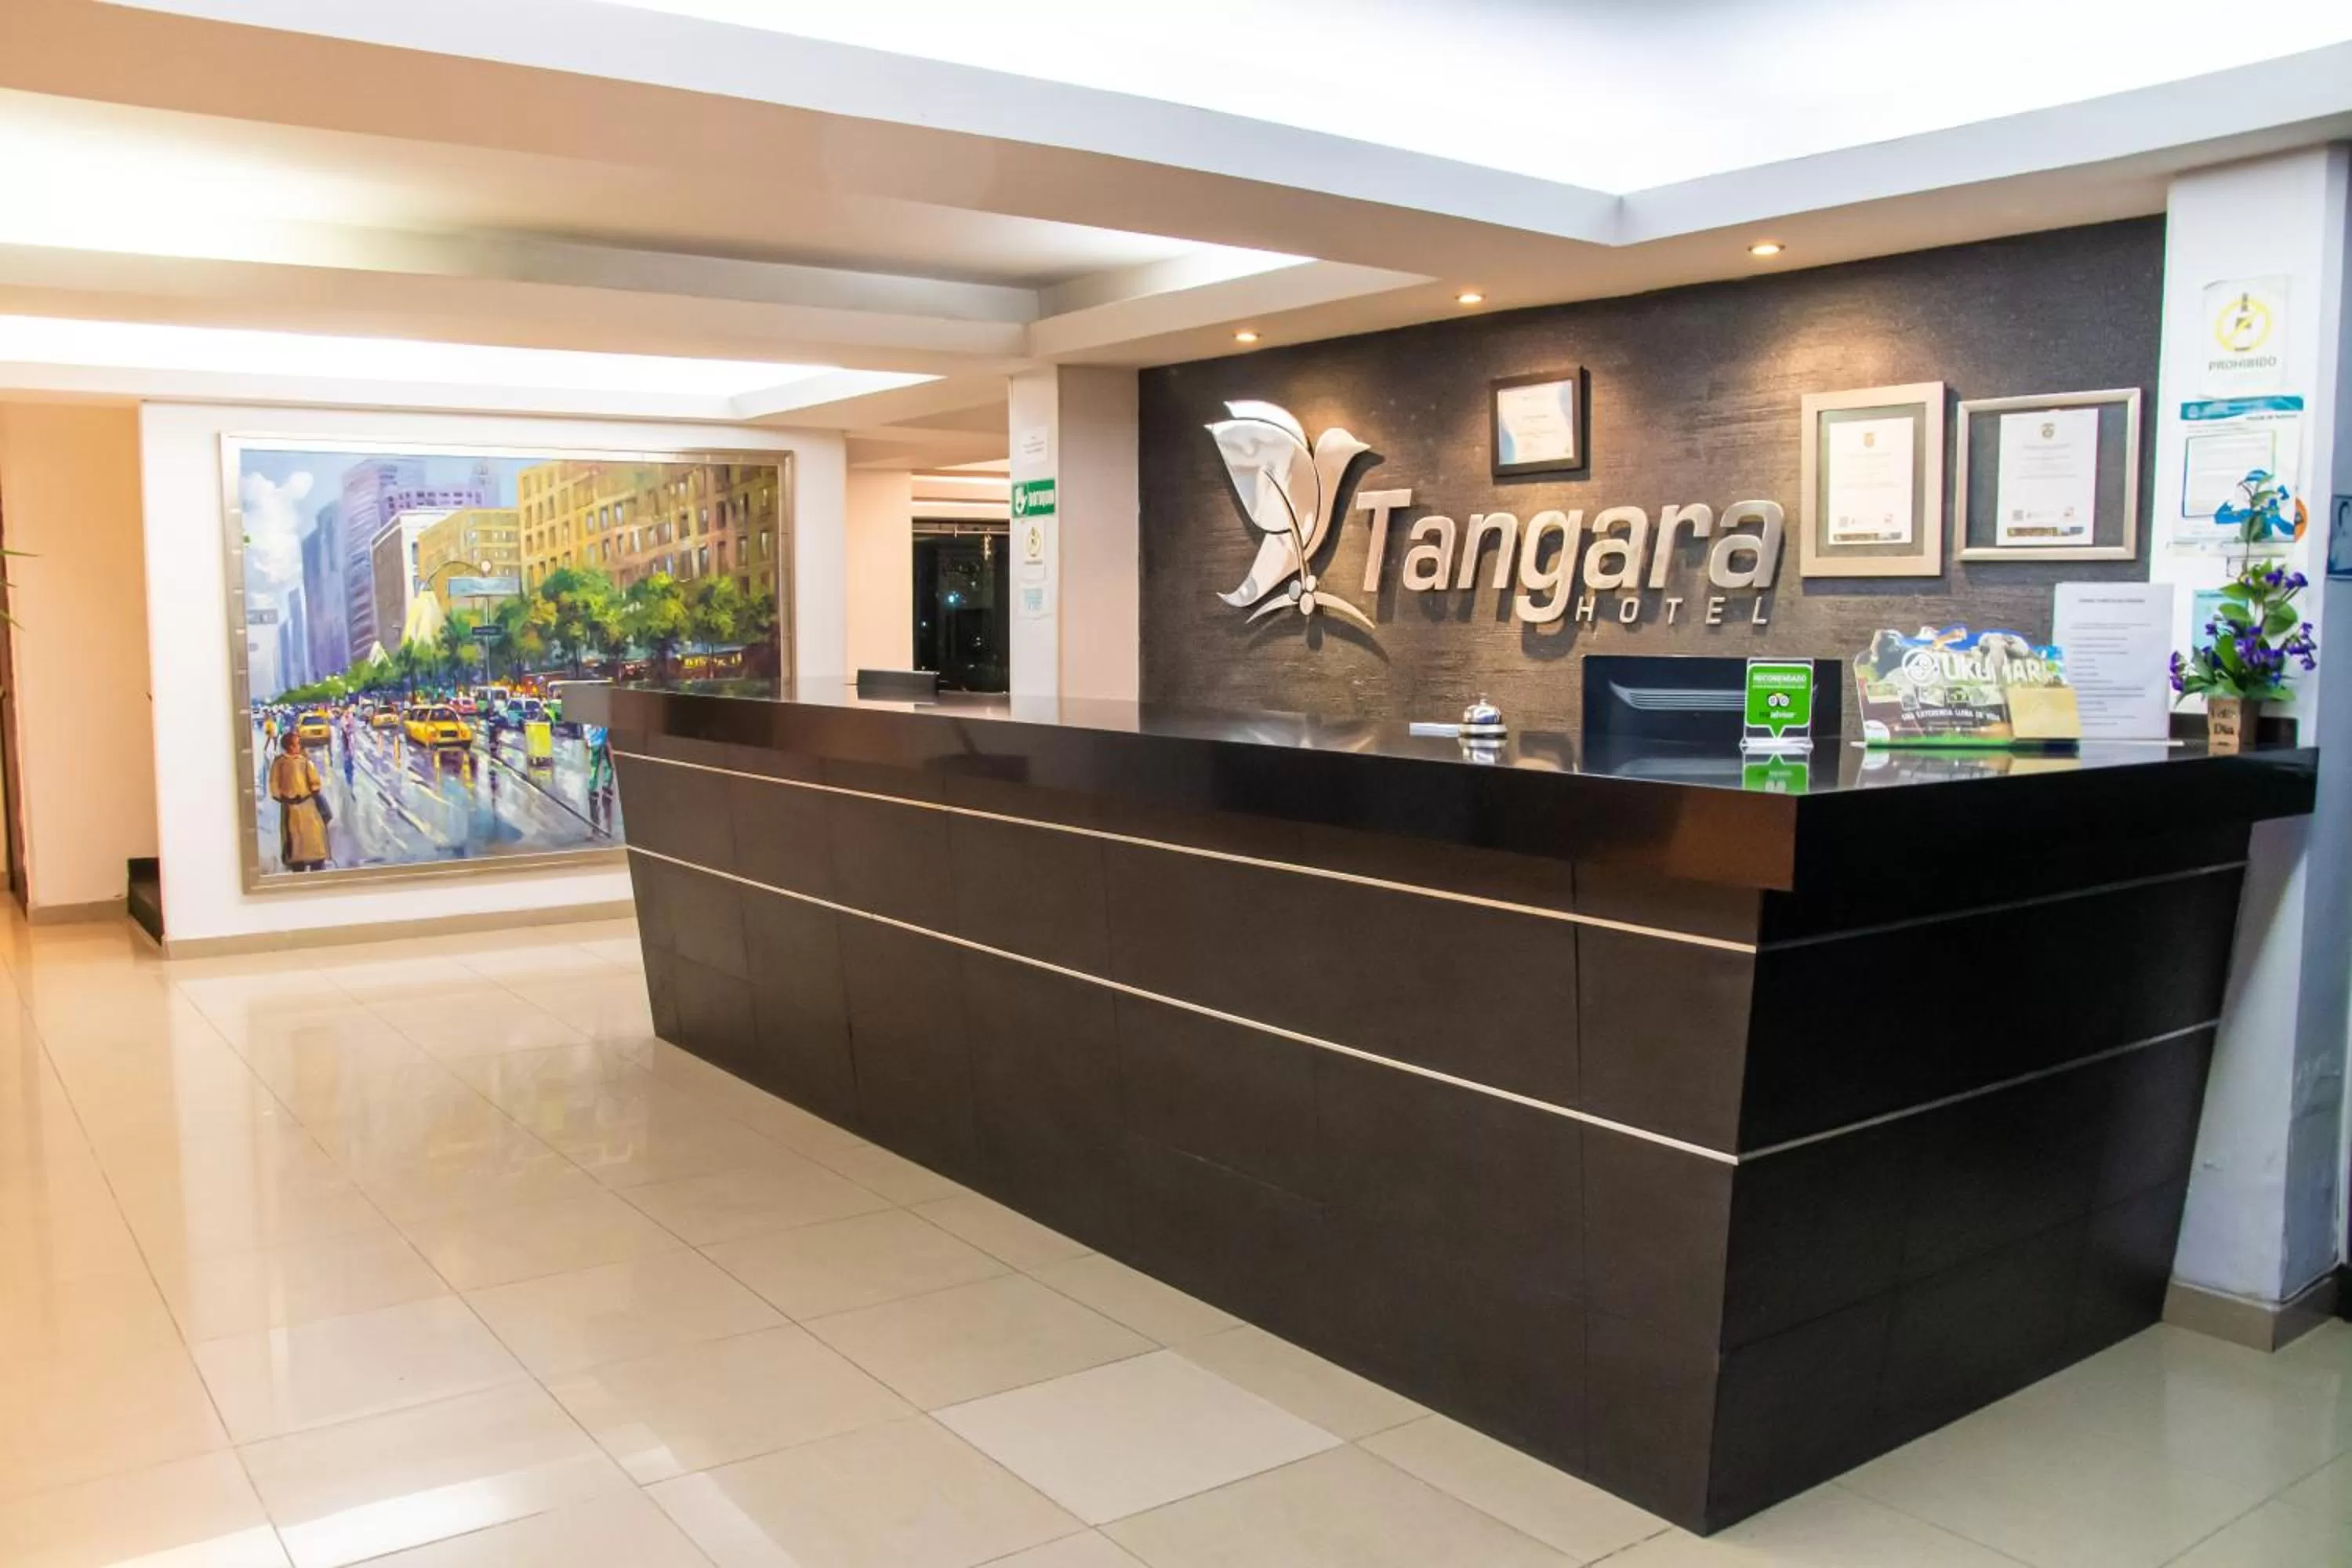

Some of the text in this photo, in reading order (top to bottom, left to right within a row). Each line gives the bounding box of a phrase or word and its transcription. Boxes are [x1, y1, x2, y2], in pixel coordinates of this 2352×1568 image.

[2209, 355, 2278, 371] PROHIBIDO
[1356, 488, 1784, 623] Tangara
[1575, 596, 1768, 625] HOTEL
